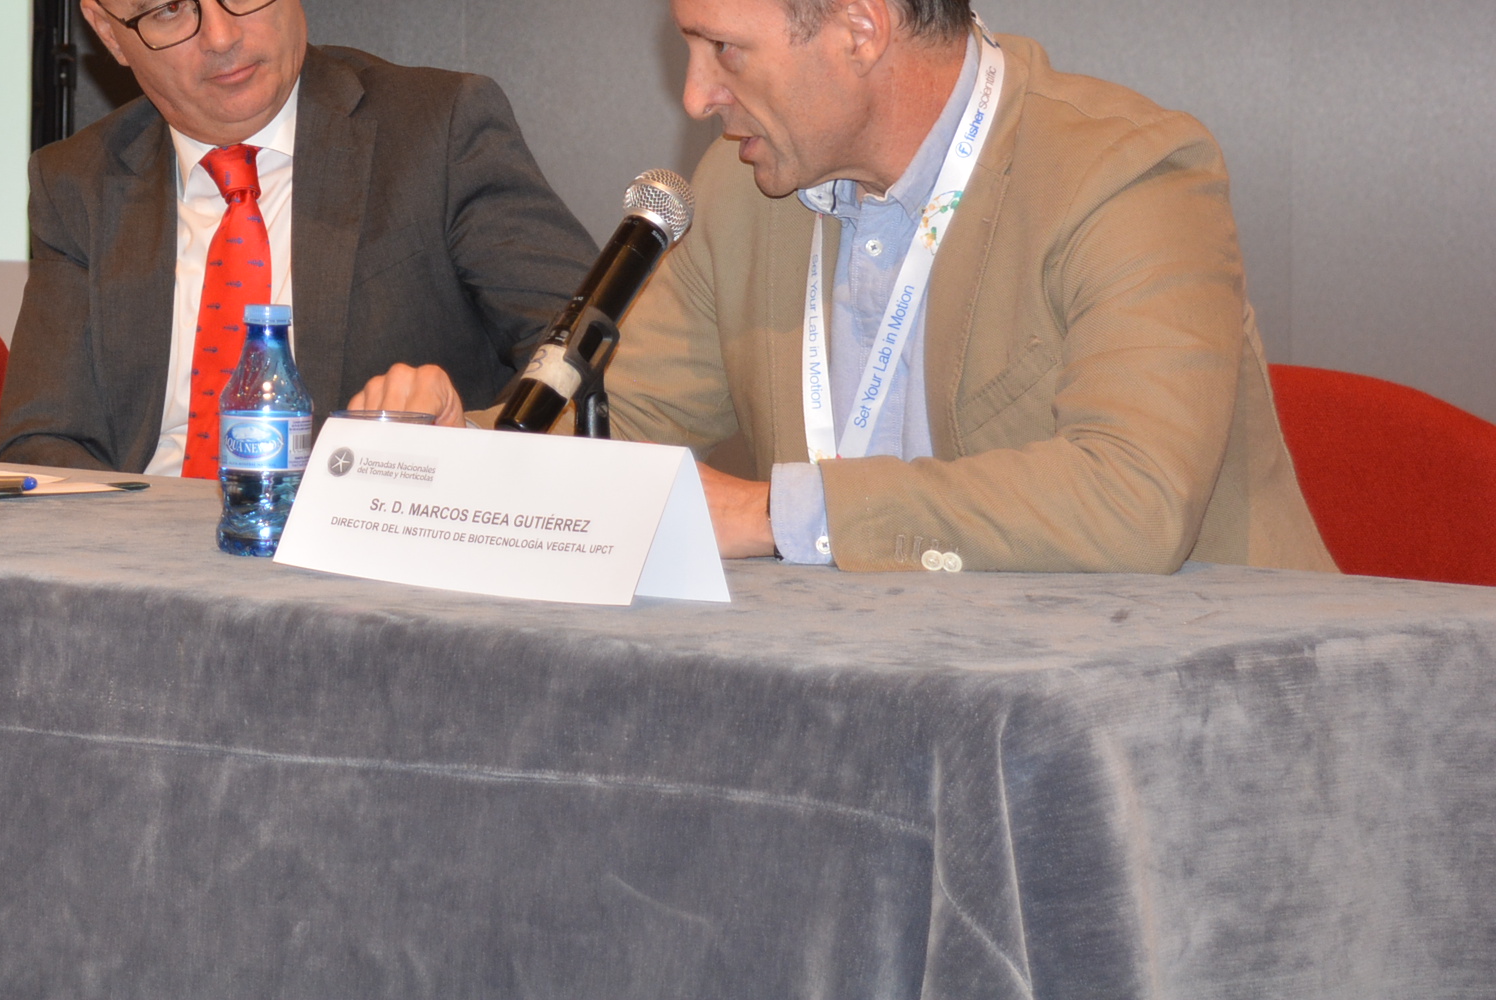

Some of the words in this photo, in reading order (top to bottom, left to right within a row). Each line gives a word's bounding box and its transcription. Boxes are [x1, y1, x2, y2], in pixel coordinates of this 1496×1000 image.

[964, 108, 985, 142] fisher
[978, 66, 997, 109] scientific
[811, 254, 819, 276] Set
[809, 280, 819, 311] Your
[888, 284, 915, 330] Motion
[808, 315, 819, 342] Lab
[882, 332, 898, 345] in
[809, 346, 820, 358] in
[873, 346, 893, 372] Lab
[809, 362, 823, 410] Motion
[861, 373, 883, 402] Your
[854, 405, 872, 428] Set
[357, 466, 368, 474] del
[369, 467, 393, 478] Tomate
[394, 471, 399, 479] y
[363, 457, 396, 469] Jornadas
[396, 462, 436, 474] Nacionales
[370, 498, 387, 512] Sr.
[391, 500, 404, 514] D.
[408, 502, 469, 522] MARCOS
[472, 510, 509, 526] EGEA
[513, 514, 591, 533] GUTIÉRREZ
[331, 516, 380, 531] DIRECTOR
[381, 522, 400, 534] DEL
[402, 526, 452, 540] INSTITUTO
[452, 532, 467, 542] DE
[467, 533, 543, 550] BIOTECNOLOGÍA
[546, 541, 587, 553] VEGETAL
[589, 544, 614, 555] UPCT
